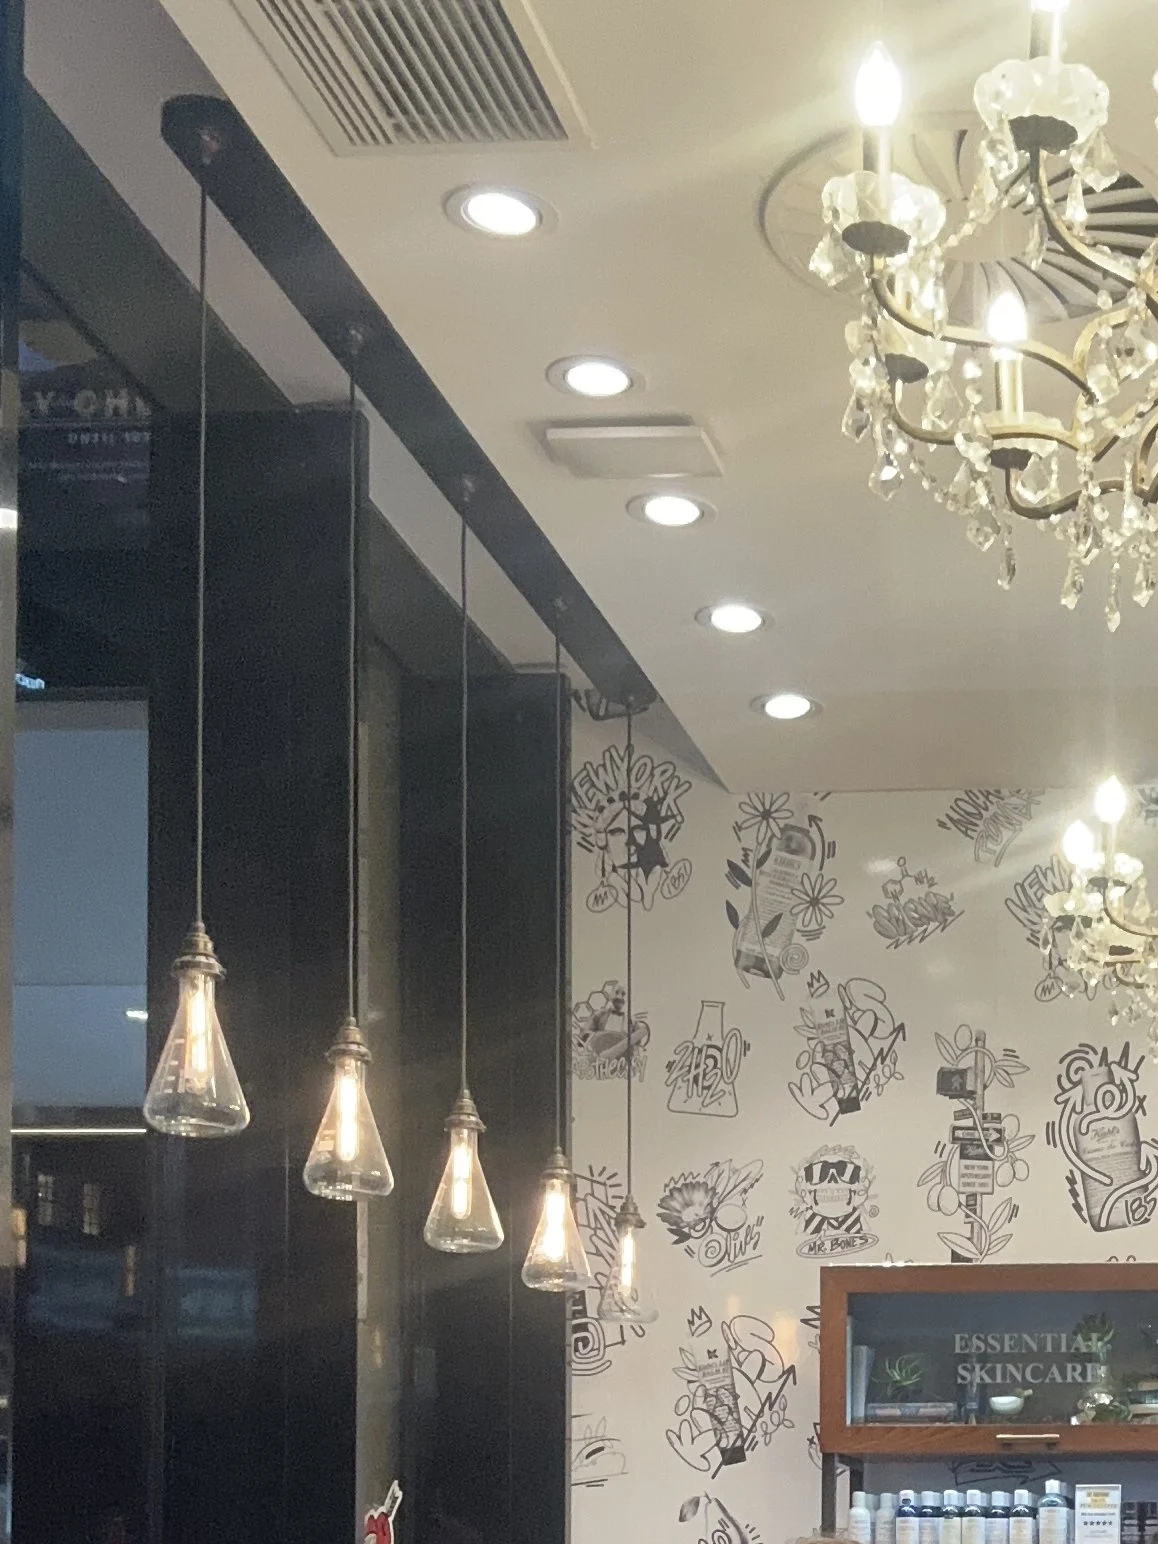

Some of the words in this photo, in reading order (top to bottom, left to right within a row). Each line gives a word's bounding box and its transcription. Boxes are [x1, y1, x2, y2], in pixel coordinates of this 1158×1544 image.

[830, 1236, 868, 1252] BONES
[954, 1332, 1103, 1355] ESSENTIAL
[957, 1362, 1107, 1385] SKINCARE
